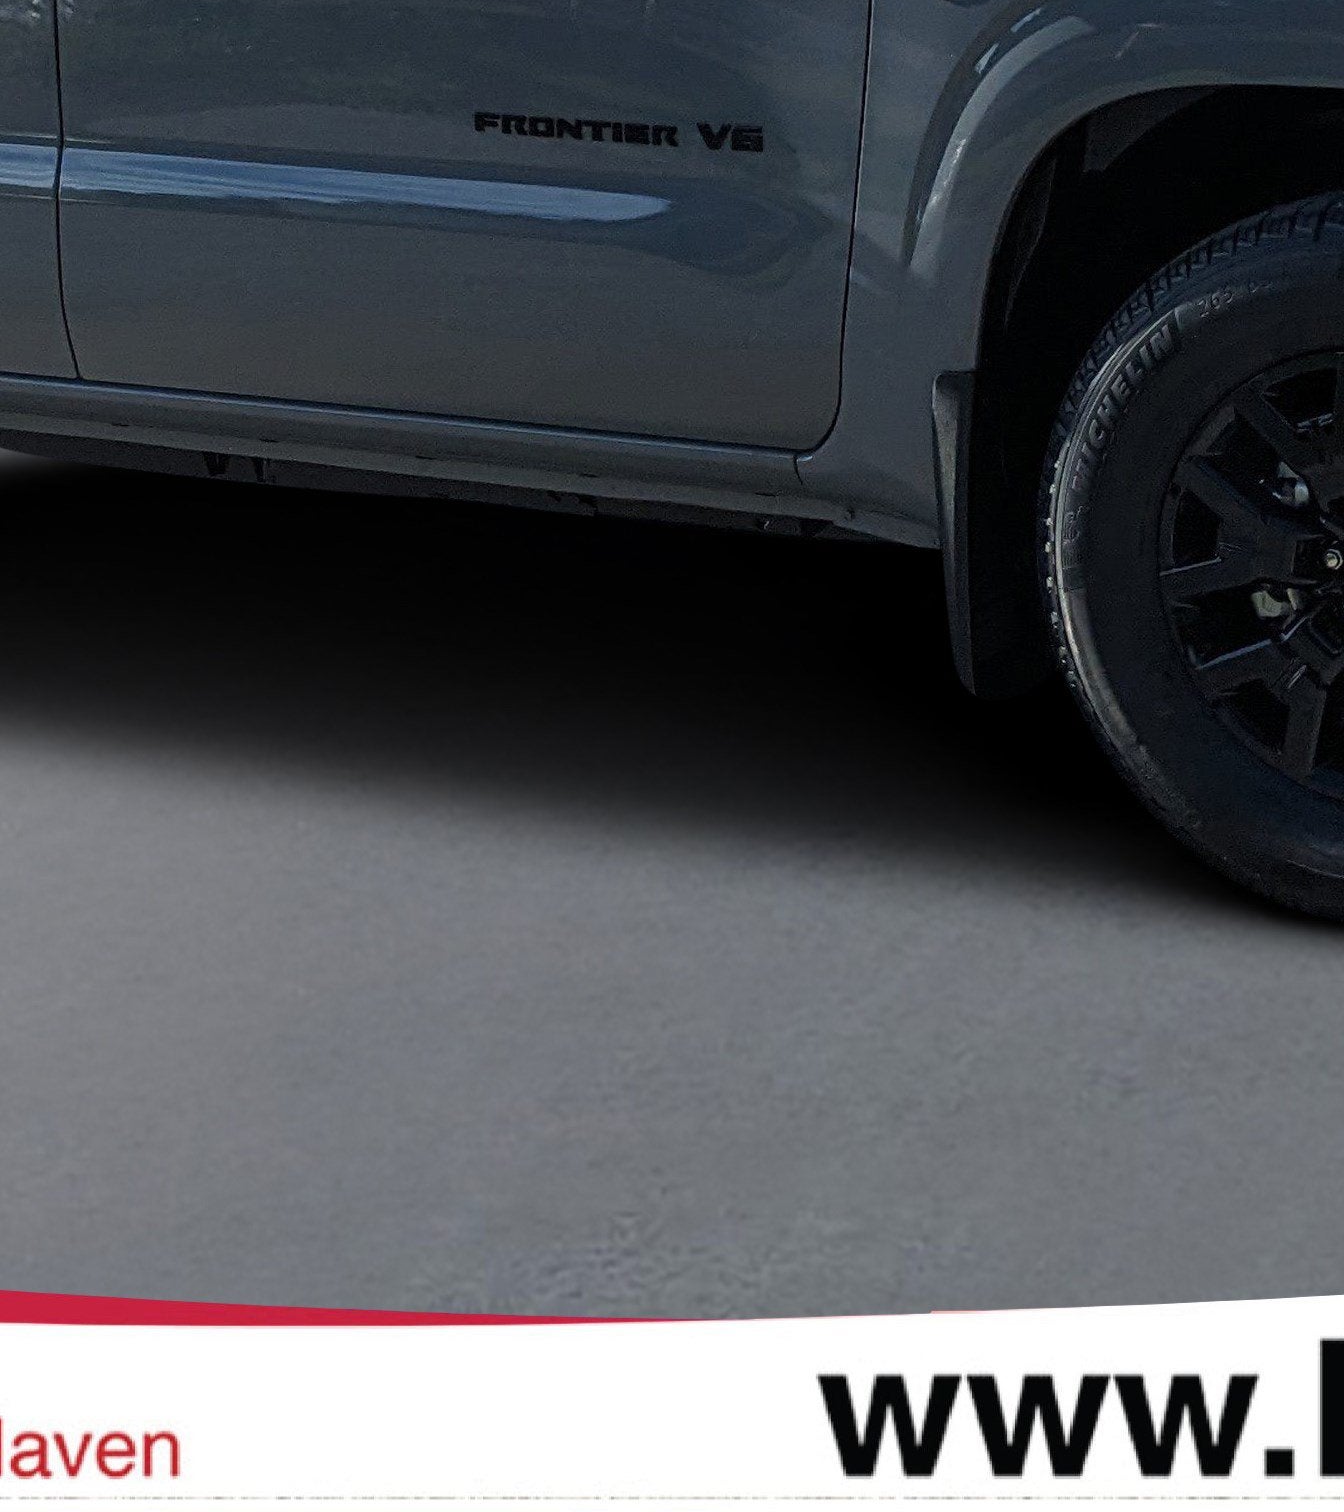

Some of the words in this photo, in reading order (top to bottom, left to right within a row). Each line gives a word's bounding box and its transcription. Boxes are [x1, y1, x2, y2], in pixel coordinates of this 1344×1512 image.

[473, 111, 679, 147] FRONTIER
[696, 122, 764, 152] V6
[1069, 324, 1175, 497] MICHELIN
